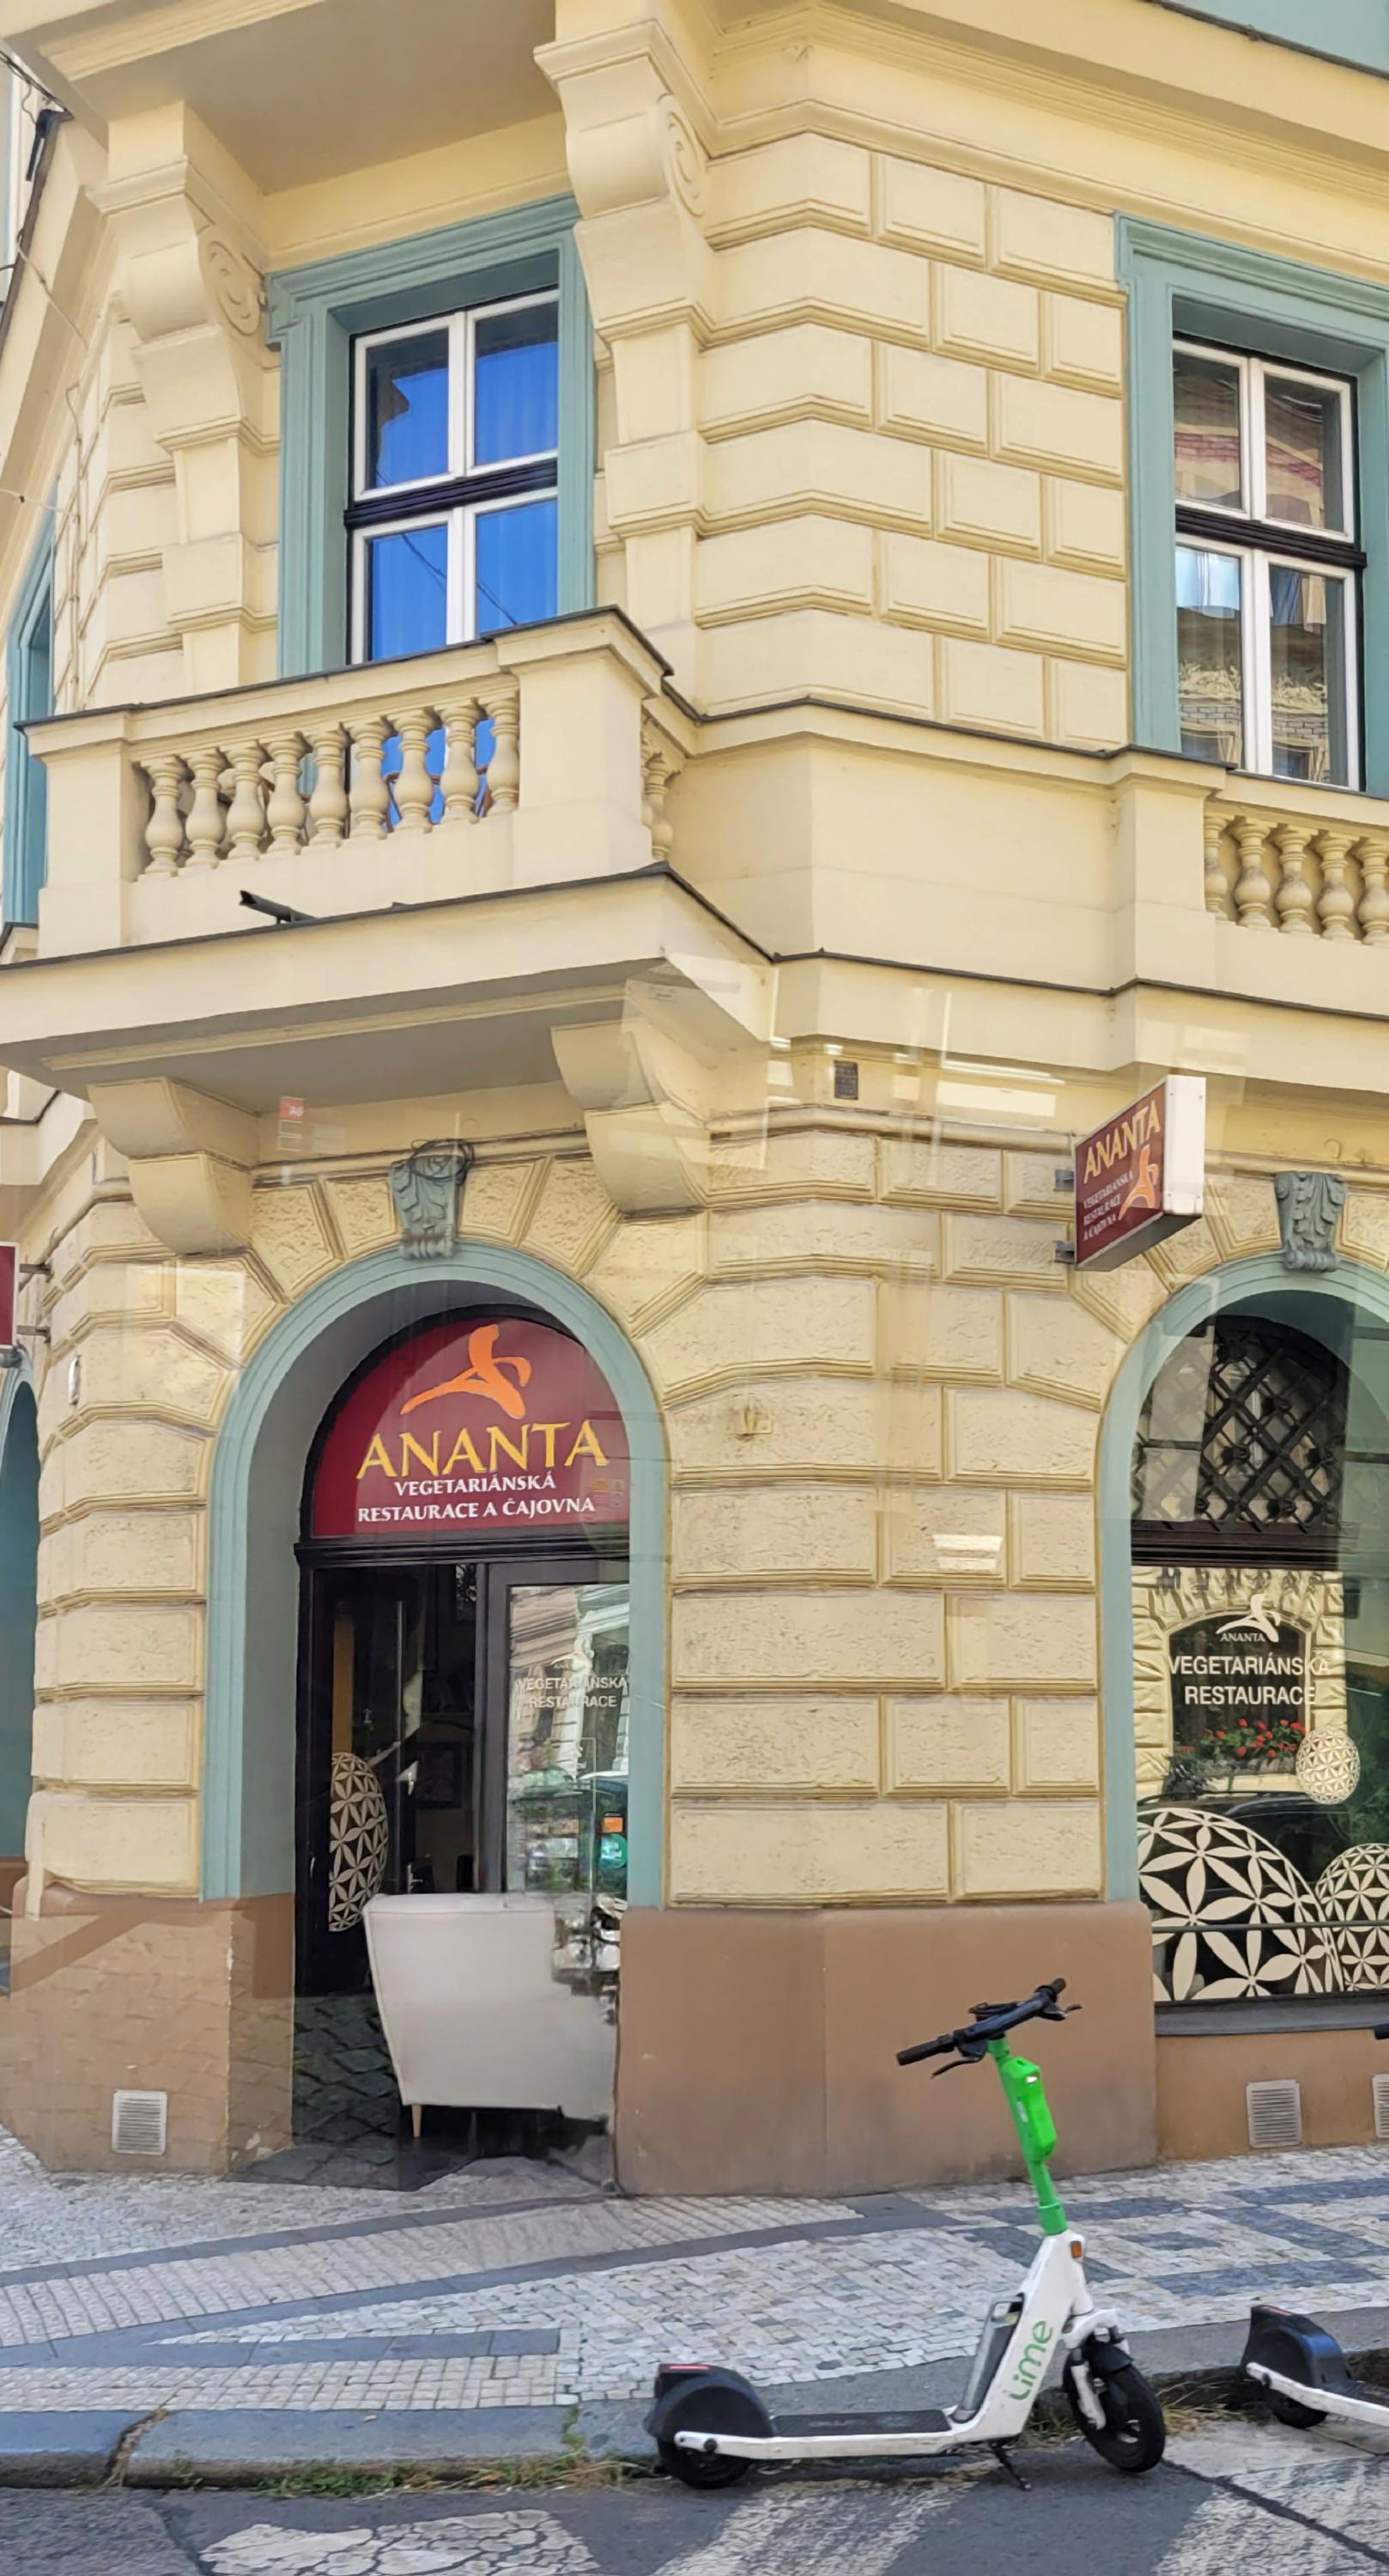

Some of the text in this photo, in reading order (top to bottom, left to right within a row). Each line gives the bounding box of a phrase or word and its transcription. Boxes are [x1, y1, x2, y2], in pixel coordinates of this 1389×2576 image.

[1083, 1100, 1161, 1184] ANANTA
[356, 1420, 608, 1479] ANANTA
[394, 1471, 555, 1497] VEGETARIÁNSKÁ
[358, 1497, 595, 1523] RESTAURACE A ČAJOVNA
[1221, 1633, 1265, 1643] ANANTA
[1169, 1653, 1330, 1675] VEGETARIÁNSKÁ
[1185, 1686, 1316, 1705] RESTAURACE
